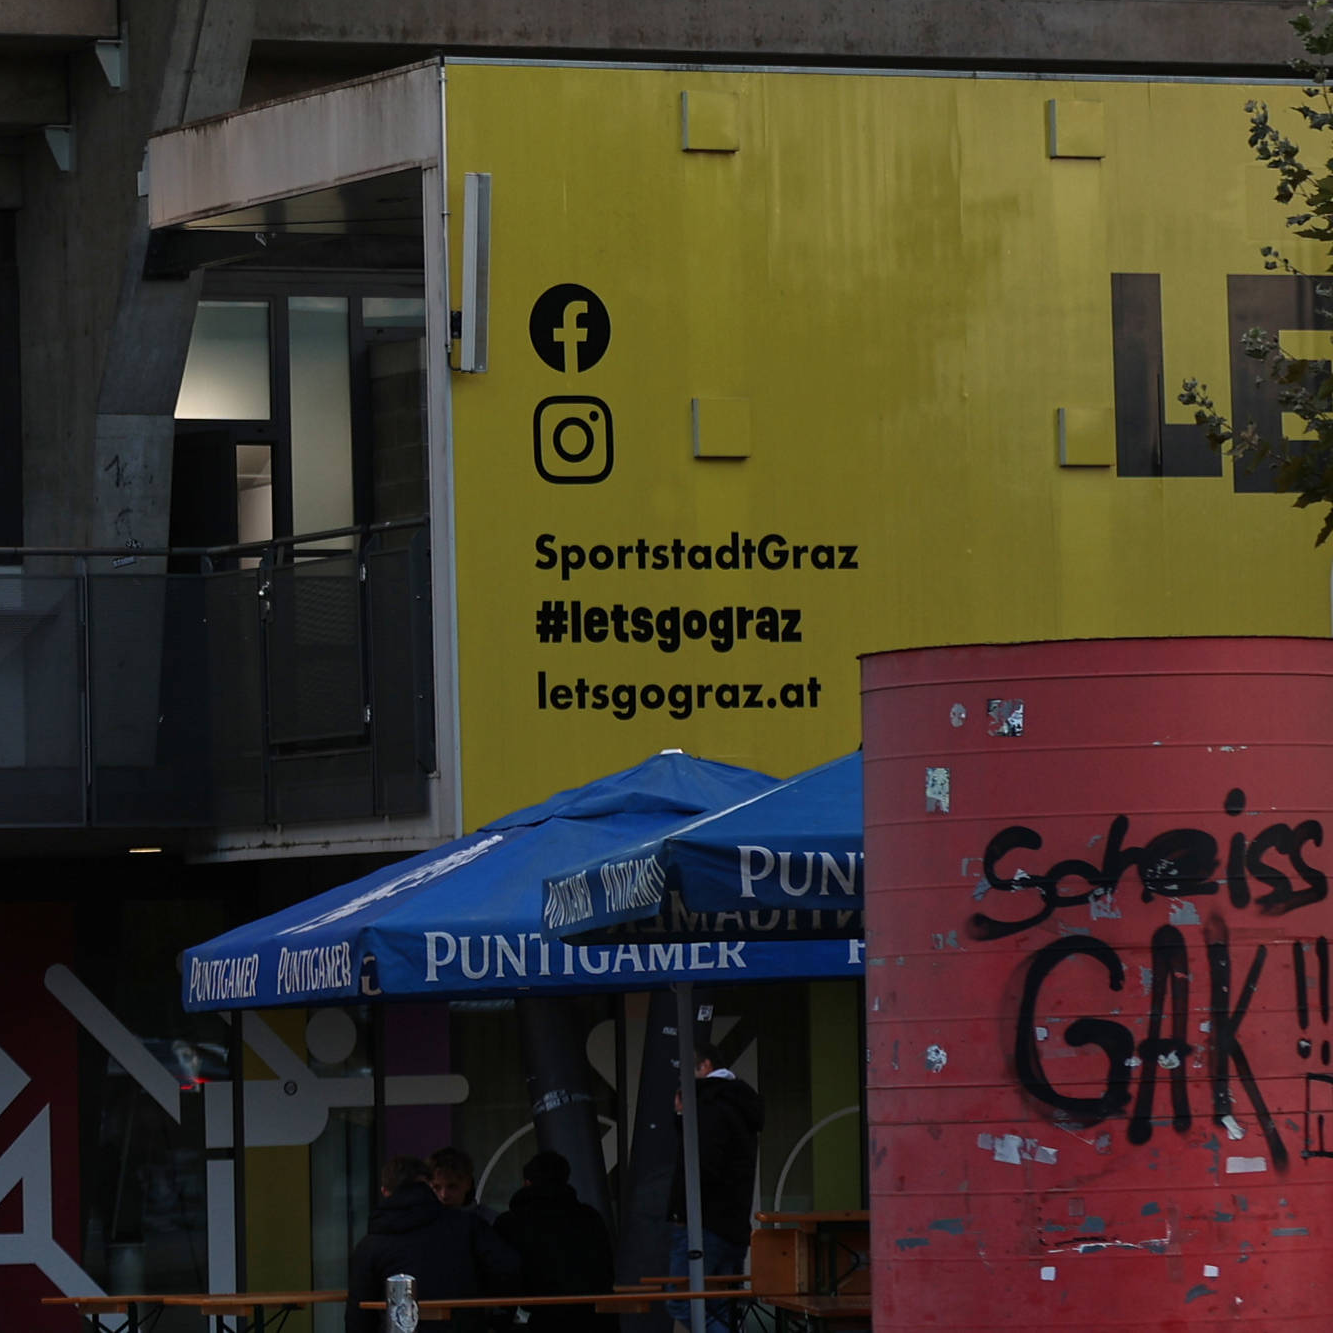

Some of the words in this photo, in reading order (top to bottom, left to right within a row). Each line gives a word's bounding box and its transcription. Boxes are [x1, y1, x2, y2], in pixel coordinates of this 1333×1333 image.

[535, 532, 859, 580] SportstadtGraz
[536, 600, 803, 653] #letsgograz
[536, 671, 822, 720] letsgograz.at
[737, 845, 864, 899] PUN
[189, 953, 260, 1004] PUNTIGAMER
[277, 941, 352, 996] PUNTIGAMER
